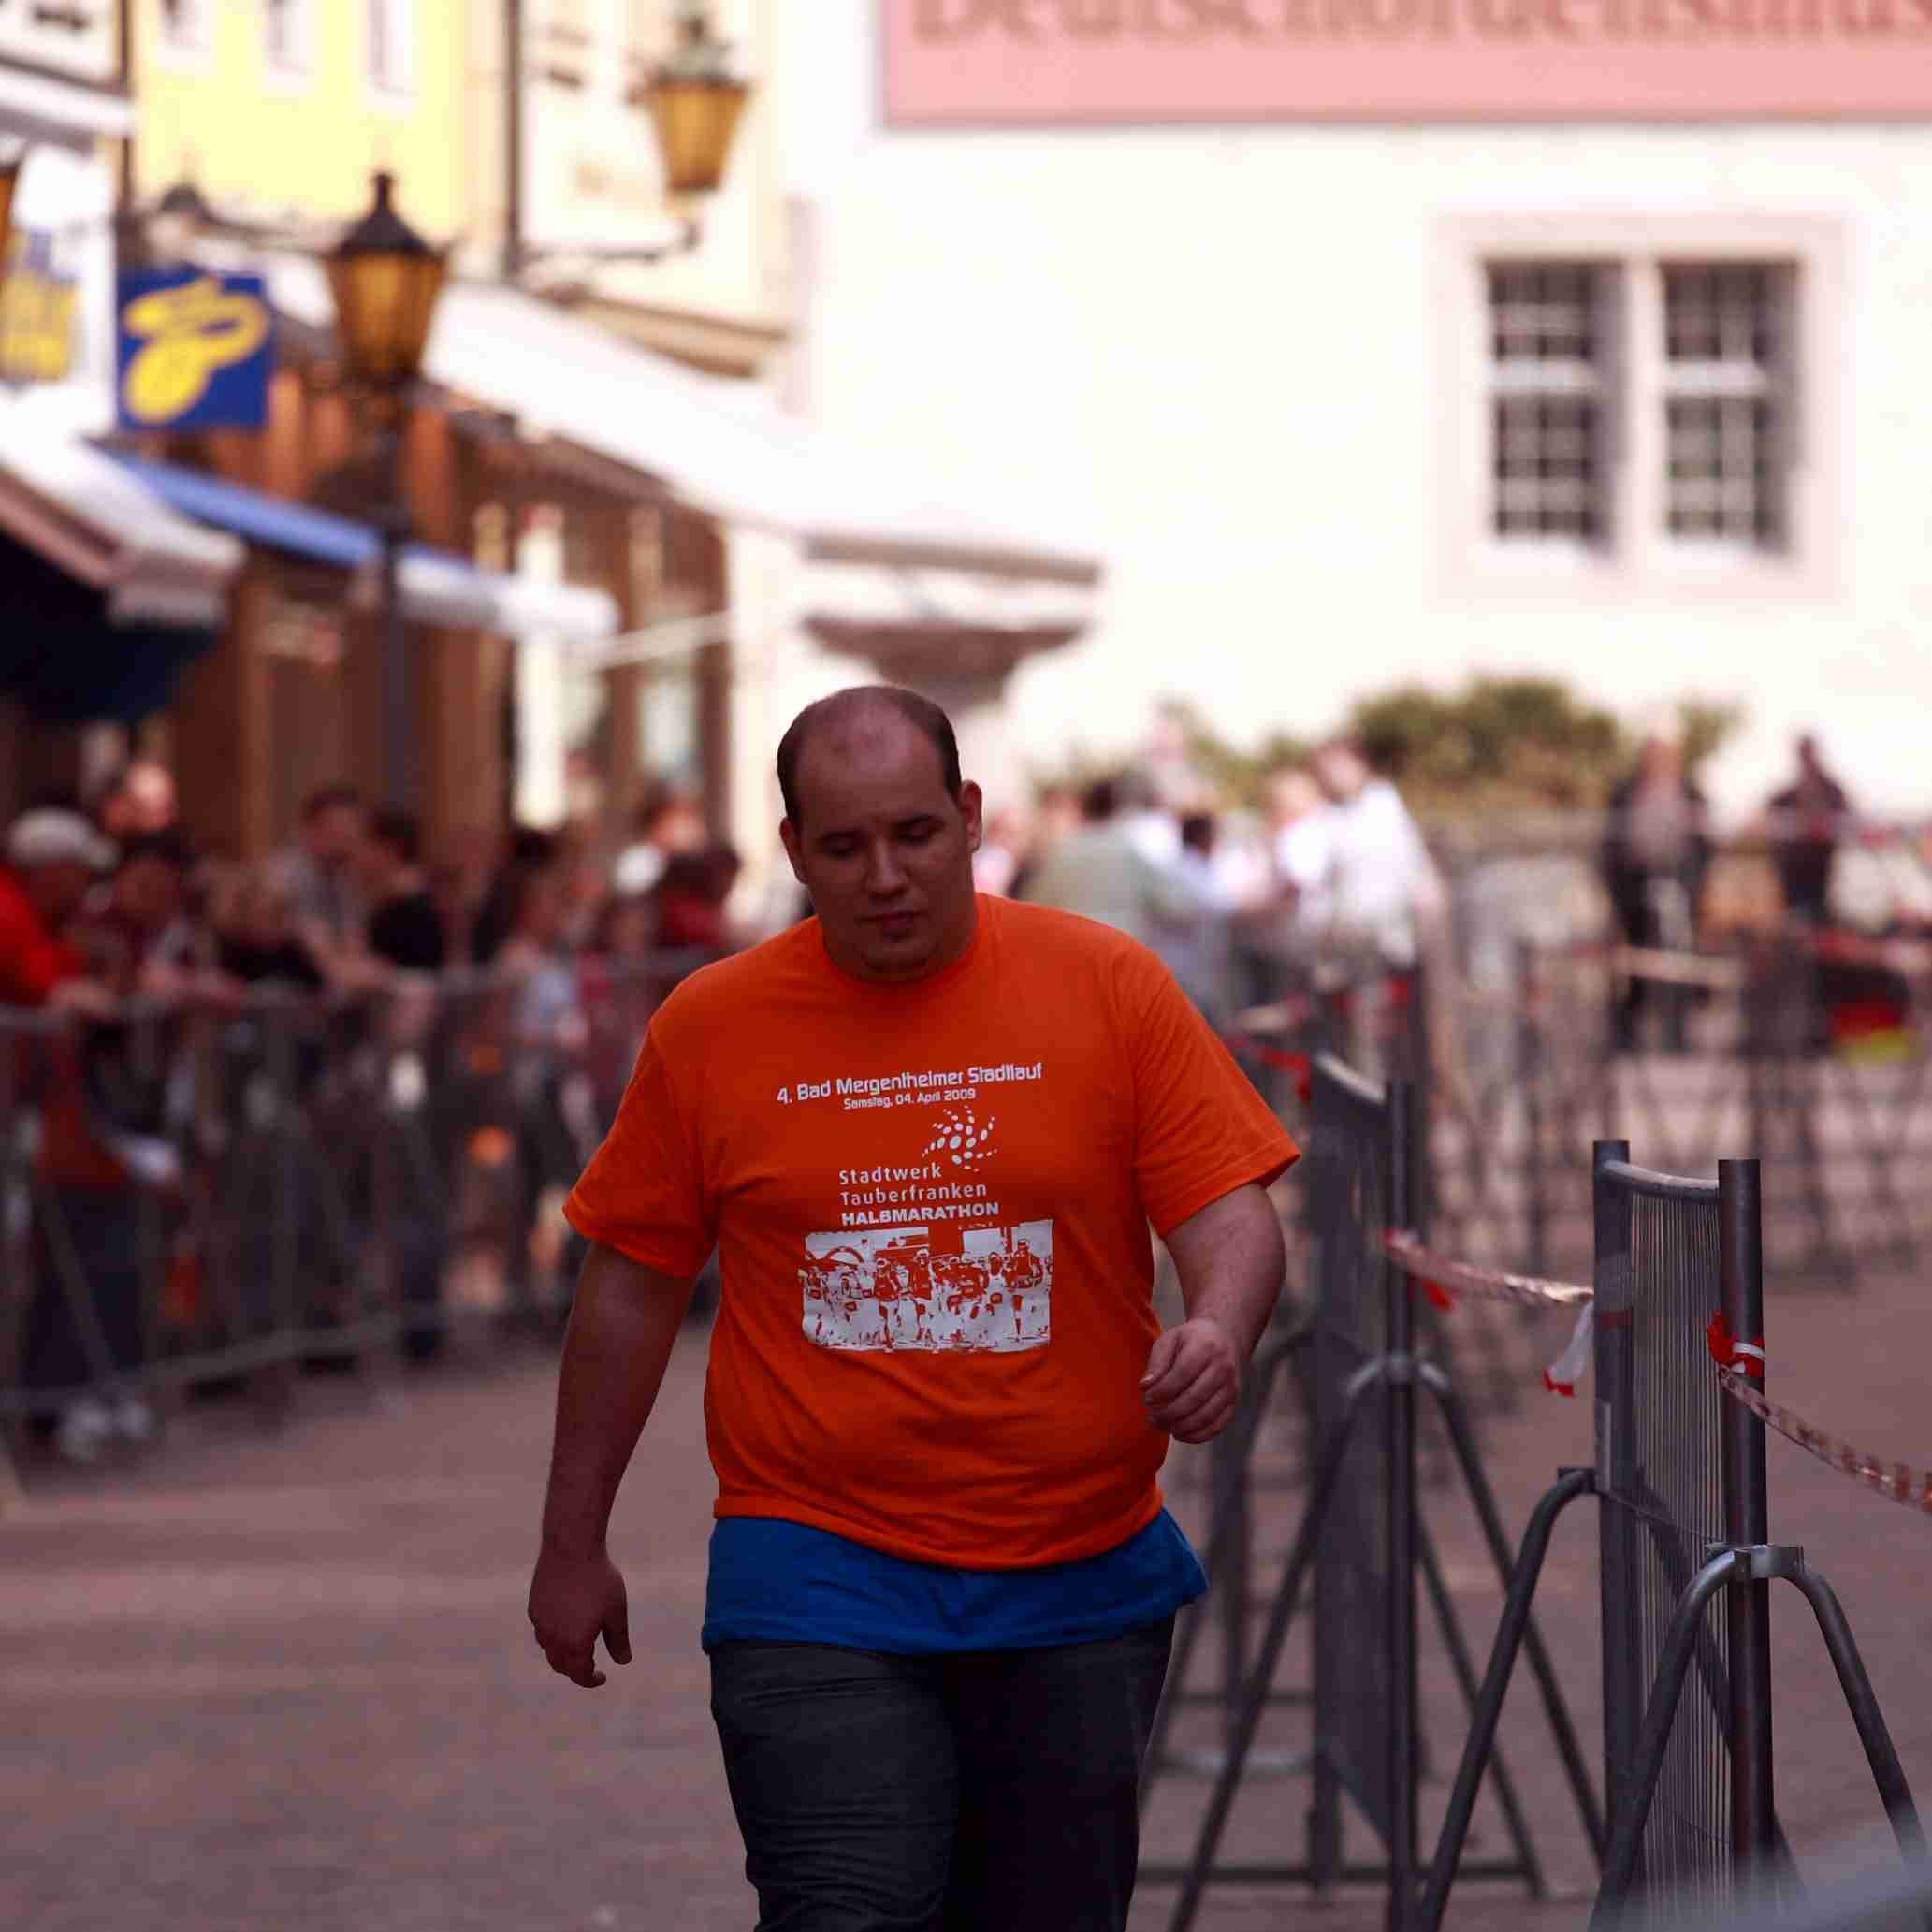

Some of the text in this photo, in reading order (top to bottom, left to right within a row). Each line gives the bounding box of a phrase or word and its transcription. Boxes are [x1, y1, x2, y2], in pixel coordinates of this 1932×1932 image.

[777, 1062, 1042, 1104] 4. Bad Mergentheimer Stadtlauf
[896, 1093, 914, 1105] 04.
[918, 1091, 940, 1104] April
[944, 1088, 976, 1101] 2009
[839, 1162, 941, 1184] Stadtwerk
[840, 1183, 986, 1205] Tauberfranken
[842, 1202, 999, 1226] HALBMARATHON
